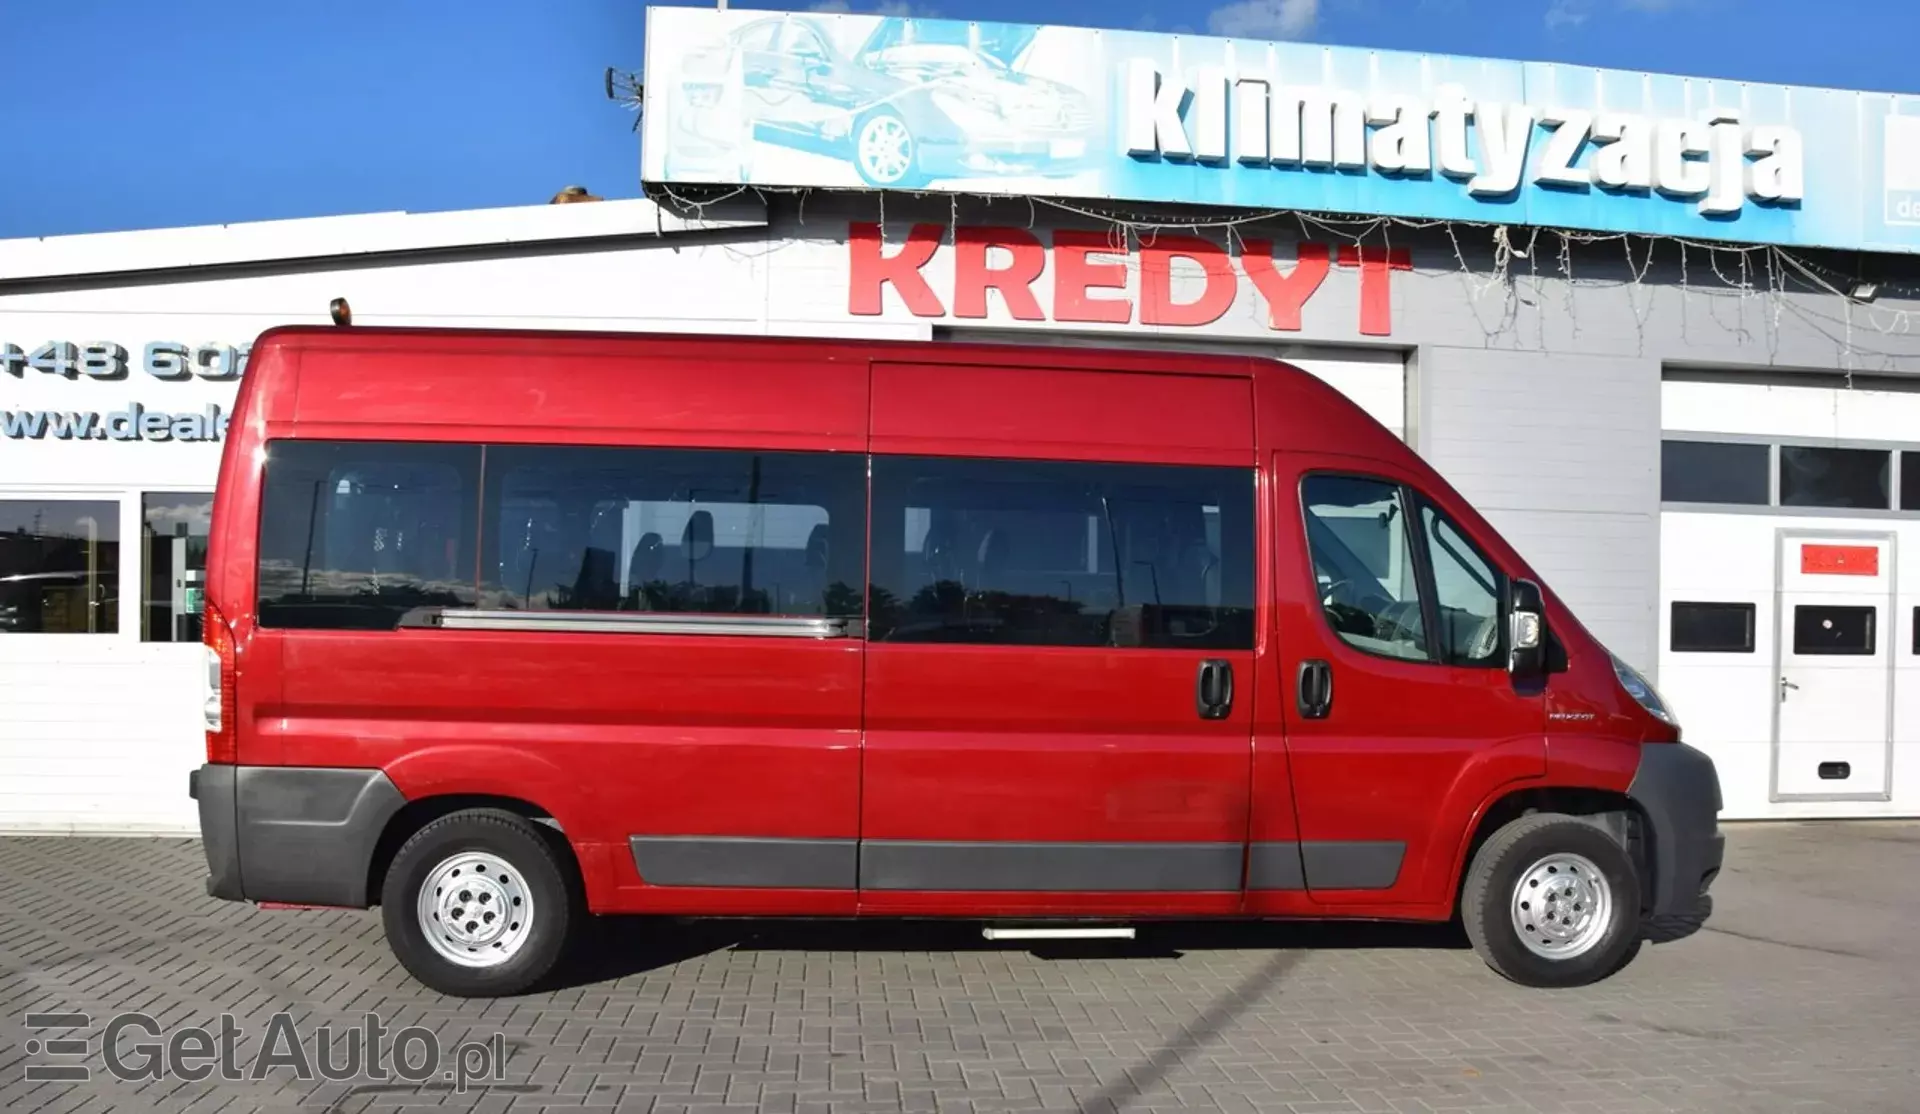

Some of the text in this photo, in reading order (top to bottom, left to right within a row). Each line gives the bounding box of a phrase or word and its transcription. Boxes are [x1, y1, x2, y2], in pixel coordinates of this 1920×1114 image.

[1127, 58, 1802, 214] klimatyzacja
[848, 221, 1412, 336] KREDYT
[0, 340, 129, 380] +48
